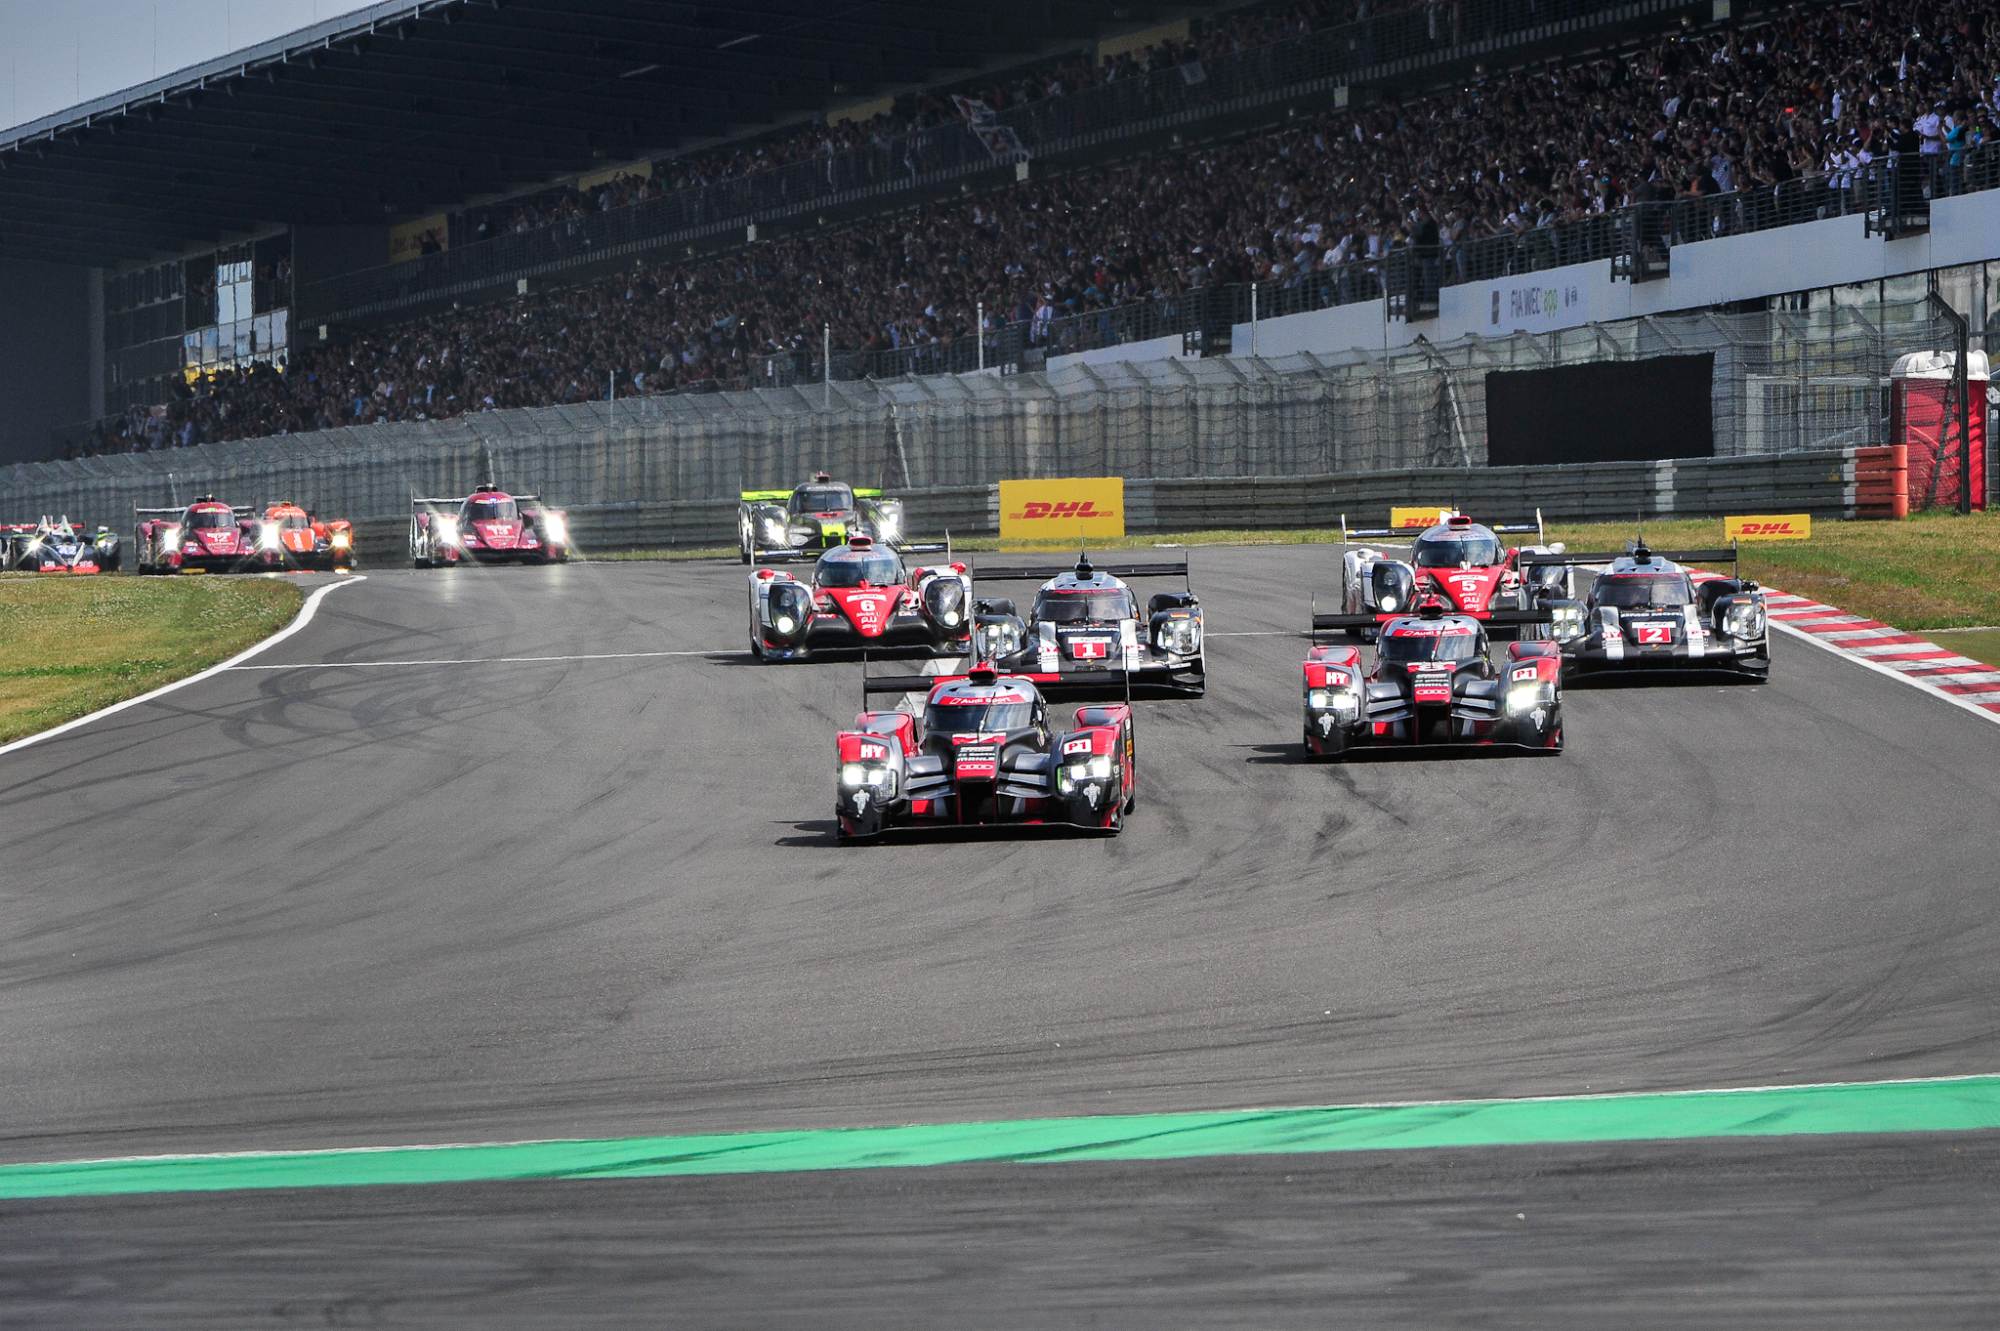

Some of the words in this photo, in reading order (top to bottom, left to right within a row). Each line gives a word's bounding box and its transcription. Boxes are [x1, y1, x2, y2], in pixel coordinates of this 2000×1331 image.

[1023, 501, 1099, 519] DHL
[1741, 522, 1794, 535] DHL
[1461, 580, 1477, 592] 5
[860, 600, 876, 612] 6
[1646, 628, 1663, 642] 2
[1082, 643, 1097, 657] 1
[1326, 671, 1347, 685] HY
[1516, 670, 1535, 680] P1
[860, 744, 885, 759] HY
[1068, 741, 1087, 751] P1
